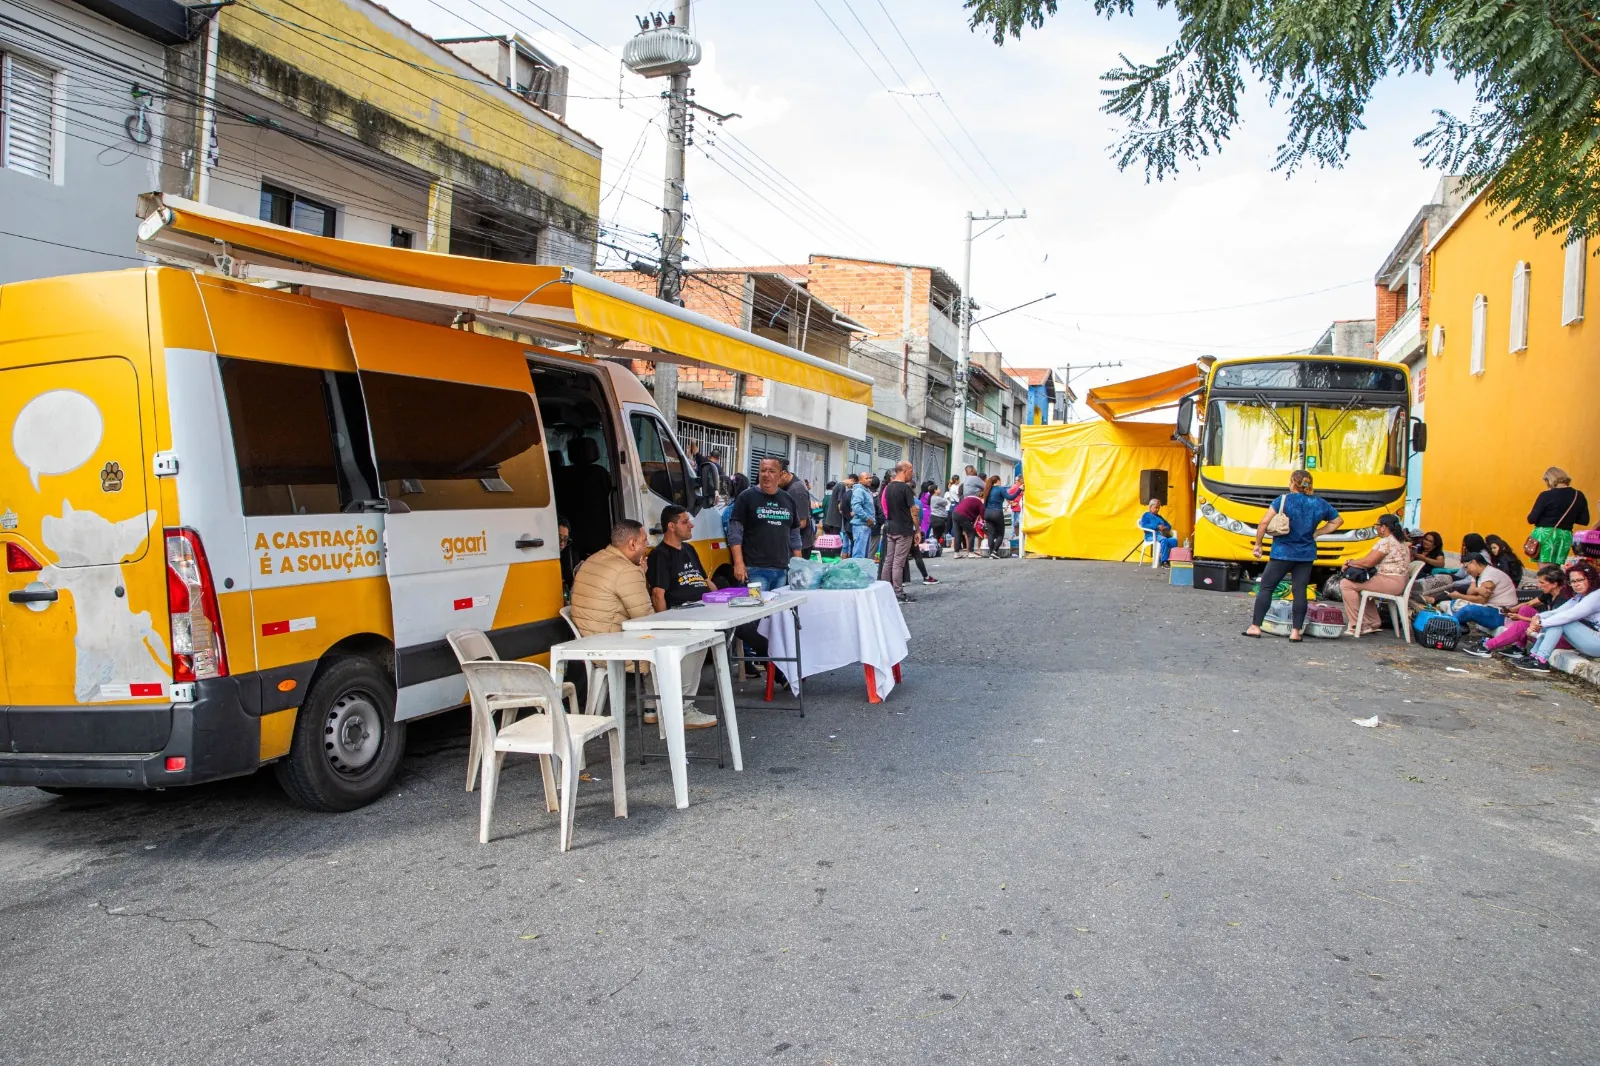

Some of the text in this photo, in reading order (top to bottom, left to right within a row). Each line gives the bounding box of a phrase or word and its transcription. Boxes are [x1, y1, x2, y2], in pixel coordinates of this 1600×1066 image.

[254, 524, 378, 551] A CASTRAÇÃO
[441, 530, 487, 560] gaari
[259, 547, 381, 575] É A SOLUÇÃO!
